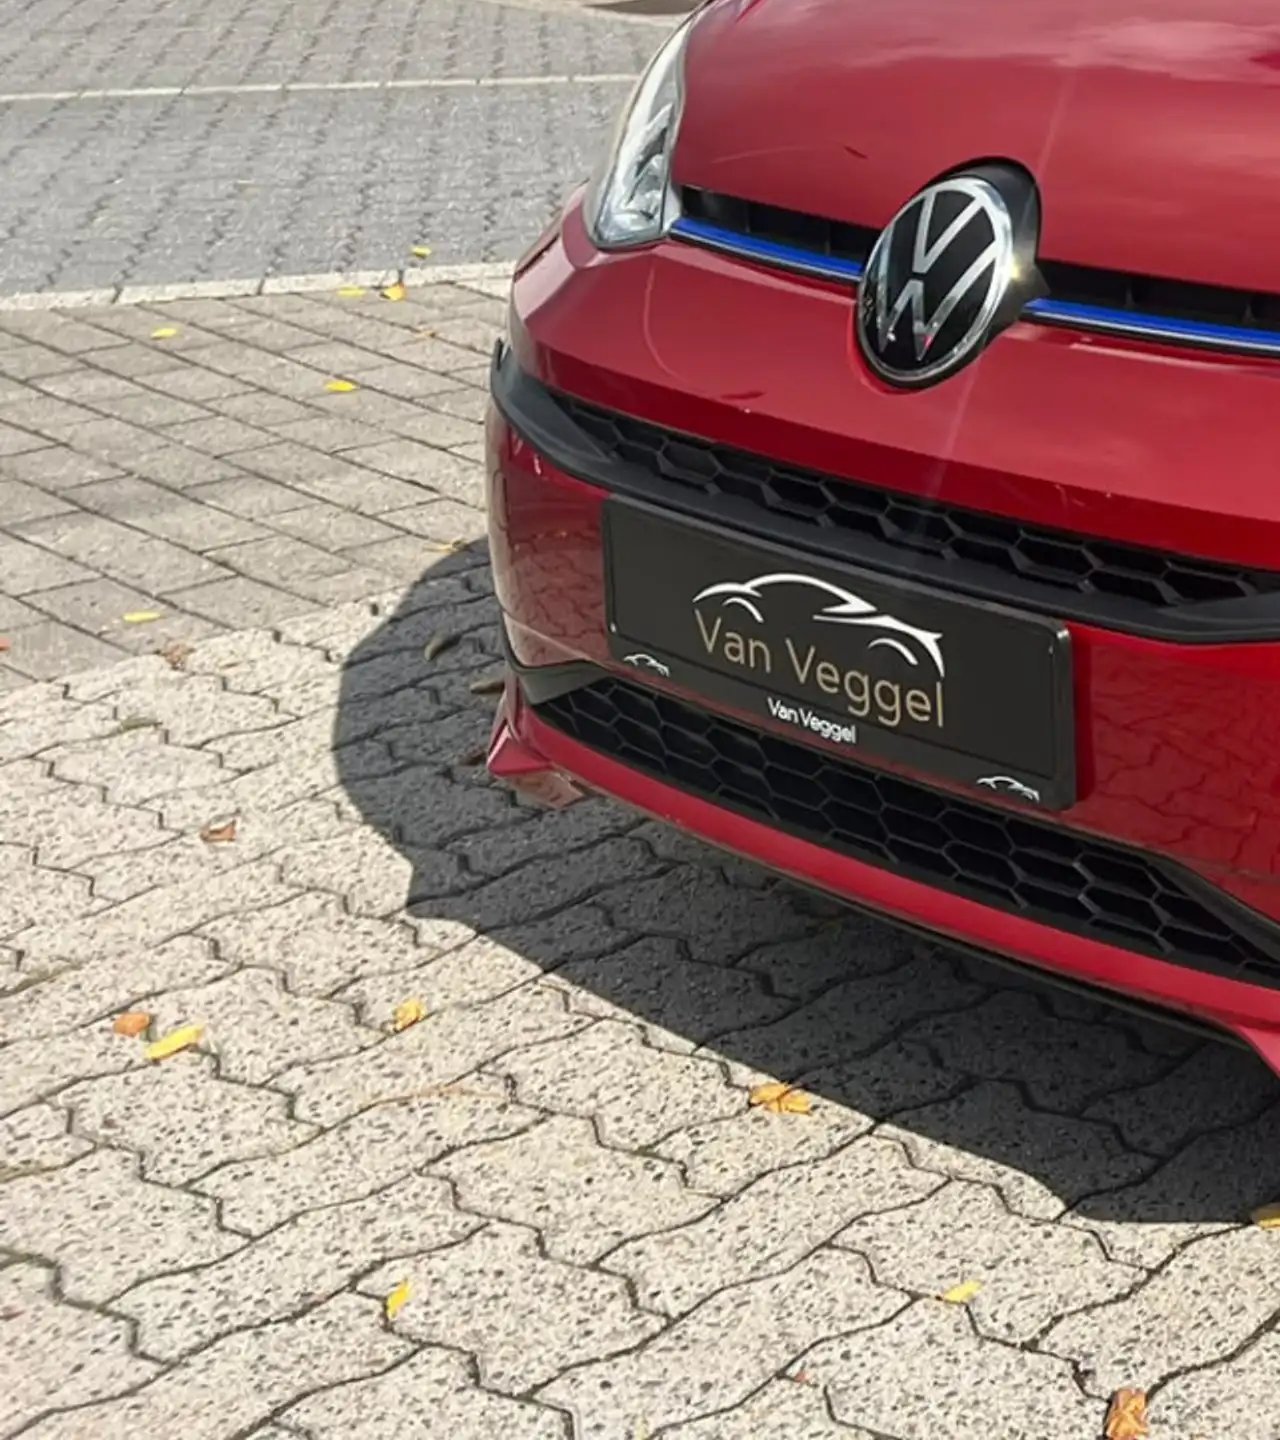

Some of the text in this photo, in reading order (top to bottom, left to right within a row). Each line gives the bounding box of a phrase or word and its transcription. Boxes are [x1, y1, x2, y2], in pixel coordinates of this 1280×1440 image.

[695, 609, 944, 728] Van Veggel
[766, 695, 856, 744] Van Veggel
